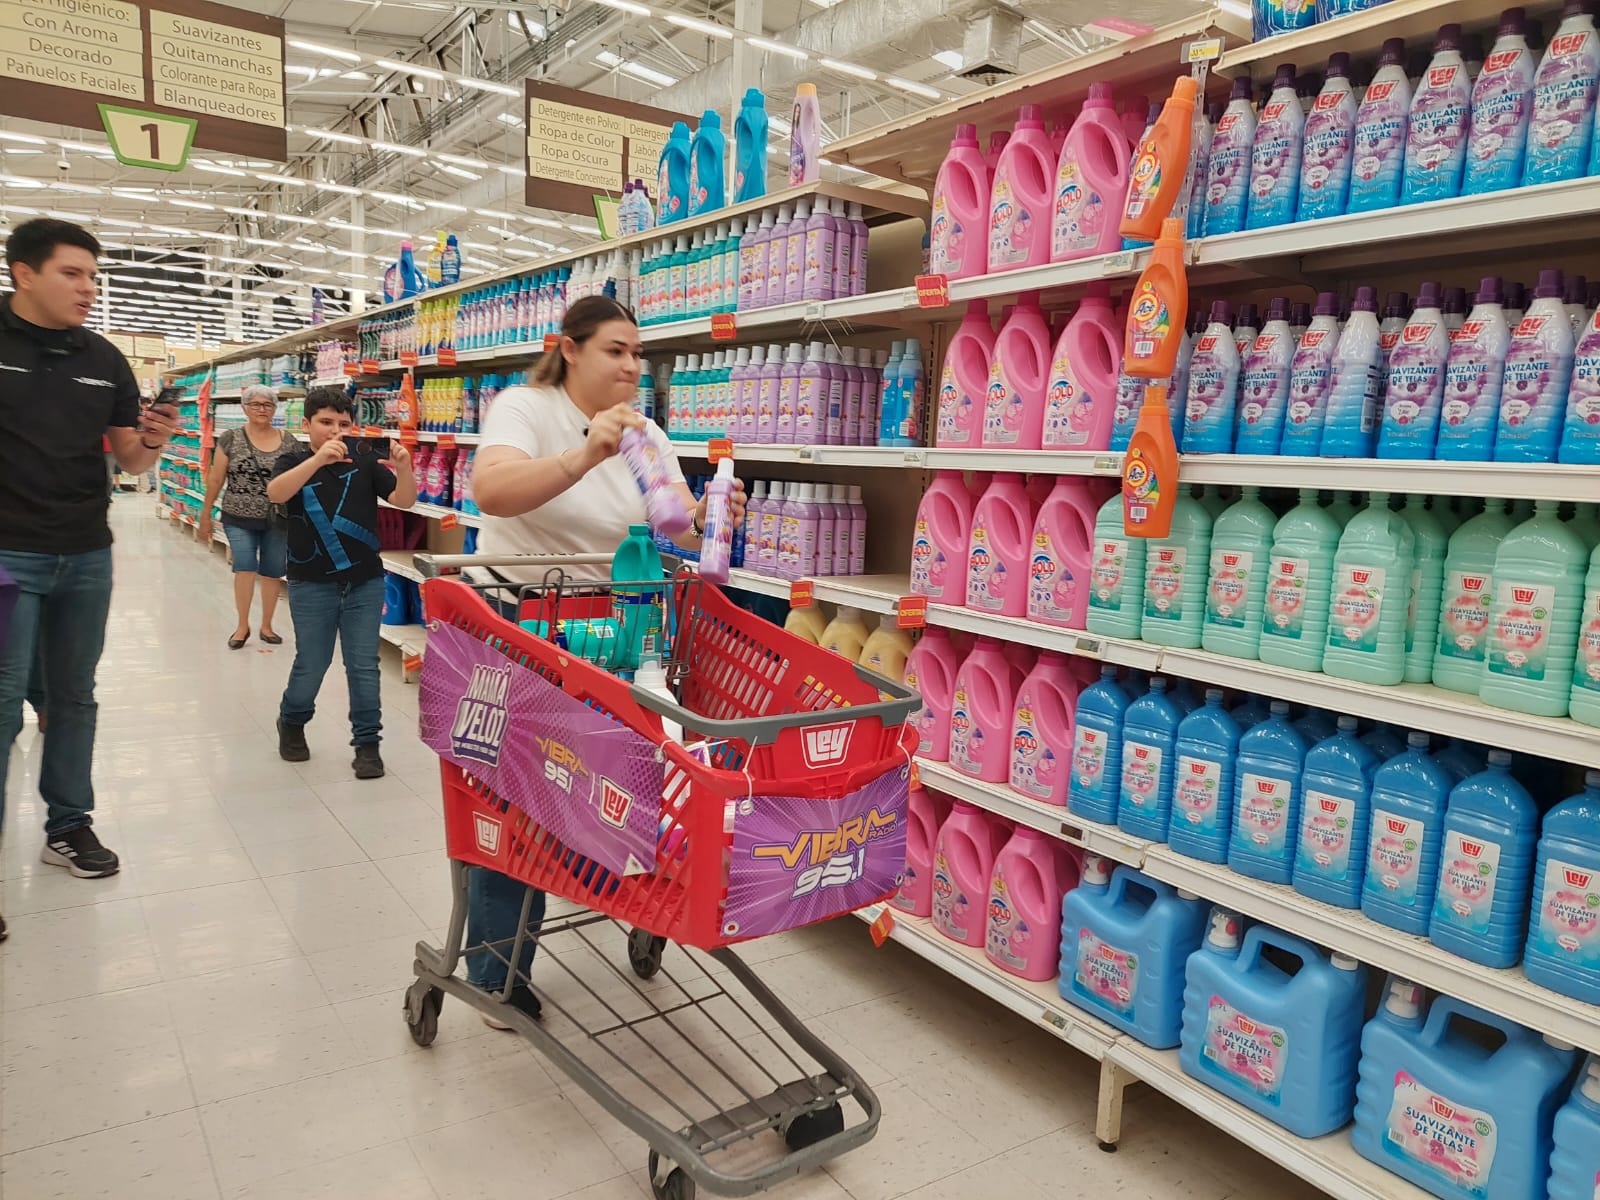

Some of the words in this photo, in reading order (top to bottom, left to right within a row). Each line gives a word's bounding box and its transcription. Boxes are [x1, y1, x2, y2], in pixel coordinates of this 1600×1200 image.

[22, 11, 57, 31] Con
[62, 19, 118, 43] Aroma
[172, 20, 262, 51] Suavizantes
[29, 37, 113, 66] Decorado
[162, 42, 273, 76] Quitamanchas
[6, 58, 77, 84] Pañuelos
[80, 69, 137, 95] Faciales
[160, 64, 218, 87] Colorante
[220, 78, 245, 93] para
[248, 82, 276, 100] Ropa
[164, 88, 277, 122] Blanqueadores
[538, 104, 584, 124] Detergente
[586, 115, 596, 125] en
[539, 124, 568, 140] Ropa
[570, 130, 584, 142] de
[587, 133, 615, 148] Color
[630, 124, 669, 141] Detergent
[1356, 121, 1400, 135] UAVIZANTE
[141, 123, 160, 160] 1
[1304, 130, 1349, 146] UAVIZANTE
[542, 144, 569, 159] Ropa
[572, 150, 609, 166] Oscura
[535, 162, 575, 179] Detergente
[575, 169, 618, 186] Concentrado
[634, 163, 658, 176] Jabó
[1389, 366, 1438, 375] UAVIZANTE
[1575, 358, 1600, 367] UAV
[1578, 367, 1592, 377] DE
[1127, 468, 1144, 480] Ace
[1032, 561, 1055, 577] BOLD
[1353, 571, 1369, 584] Ley
[1463, 577, 1483, 590] Ley
[1514, 589, 1535, 604] Ley
[1500, 620, 1542, 632] SUAVIZANTE
[1516, 629, 1535, 637] TELAS
[452, 700, 506, 747] VELOZ
[807, 728, 849, 761] Ley
[1015, 737, 1037, 749] BOLD
[535, 736, 589, 777] VIBRA
[1258, 781, 1275, 793] Ley
[604, 783, 628, 821] Ley
[1320, 800, 1337, 813] Ley
[477, 817, 499, 850] Ley
[869, 824, 896, 841] RADIO
[1387, 820, 1406, 834] Ley
[754, 808, 896, 867] VIBRA
[1461, 840, 1481, 856] Ley
[792, 848, 864, 897] 95.1
[1448, 869, 1487, 887] SUAVIZANTE
[1565, 870, 1589, 887] Ley
[1452, 877, 1461, 885] DE
[1462, 880, 1480, 890] TELAS
[989, 904, 1011, 919] BOLD
[1549, 900, 1597, 919] SUAVIZANTE
[1568, 913, 1589, 923] TELAS
[1085, 954, 1127, 980] SUAVIZANTE
[1091, 965, 1102, 975] DE
[1101, 969, 1121, 985] TELAS
[1216, 1026, 1272, 1058] SUAVIZANTE
[1225, 1038, 1236, 1050] DE
[1238, 1044, 1262, 1064] TELAS
[1434, 1101, 1452, 1119] Ley
[1406, 1106, 1476, 1148] SUAVIZANTE
[1476, 1124, 1489, 1133] BIO
[1415, 1122, 1428, 1135] DE
[1432, 1129, 1463, 1153] TELAS
